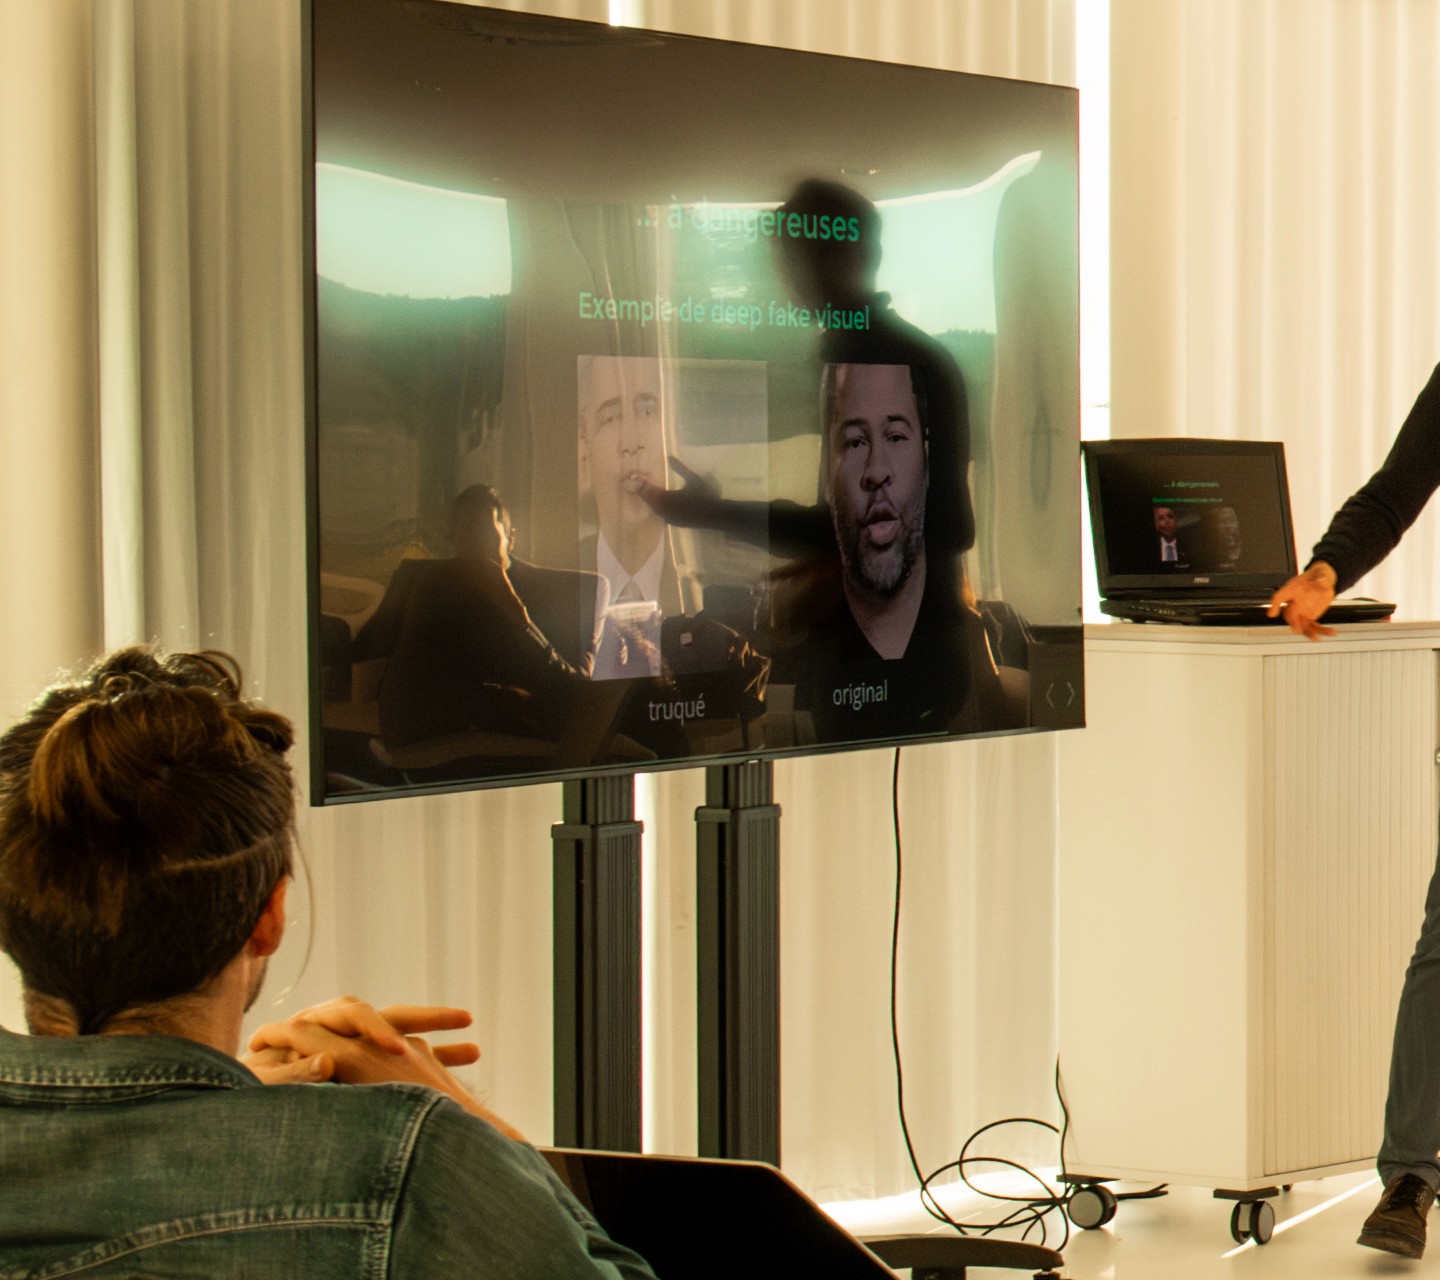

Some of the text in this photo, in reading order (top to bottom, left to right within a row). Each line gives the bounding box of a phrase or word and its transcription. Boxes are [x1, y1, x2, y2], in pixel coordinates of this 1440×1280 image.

[667, 195, 683, 231] à
[690, 196, 860, 243] dangereuses
[578, 292, 870, 331] Exemple de deep fake visuel
[649, 693, 706, 727] truqué
[832, 679, 888, 711] original
